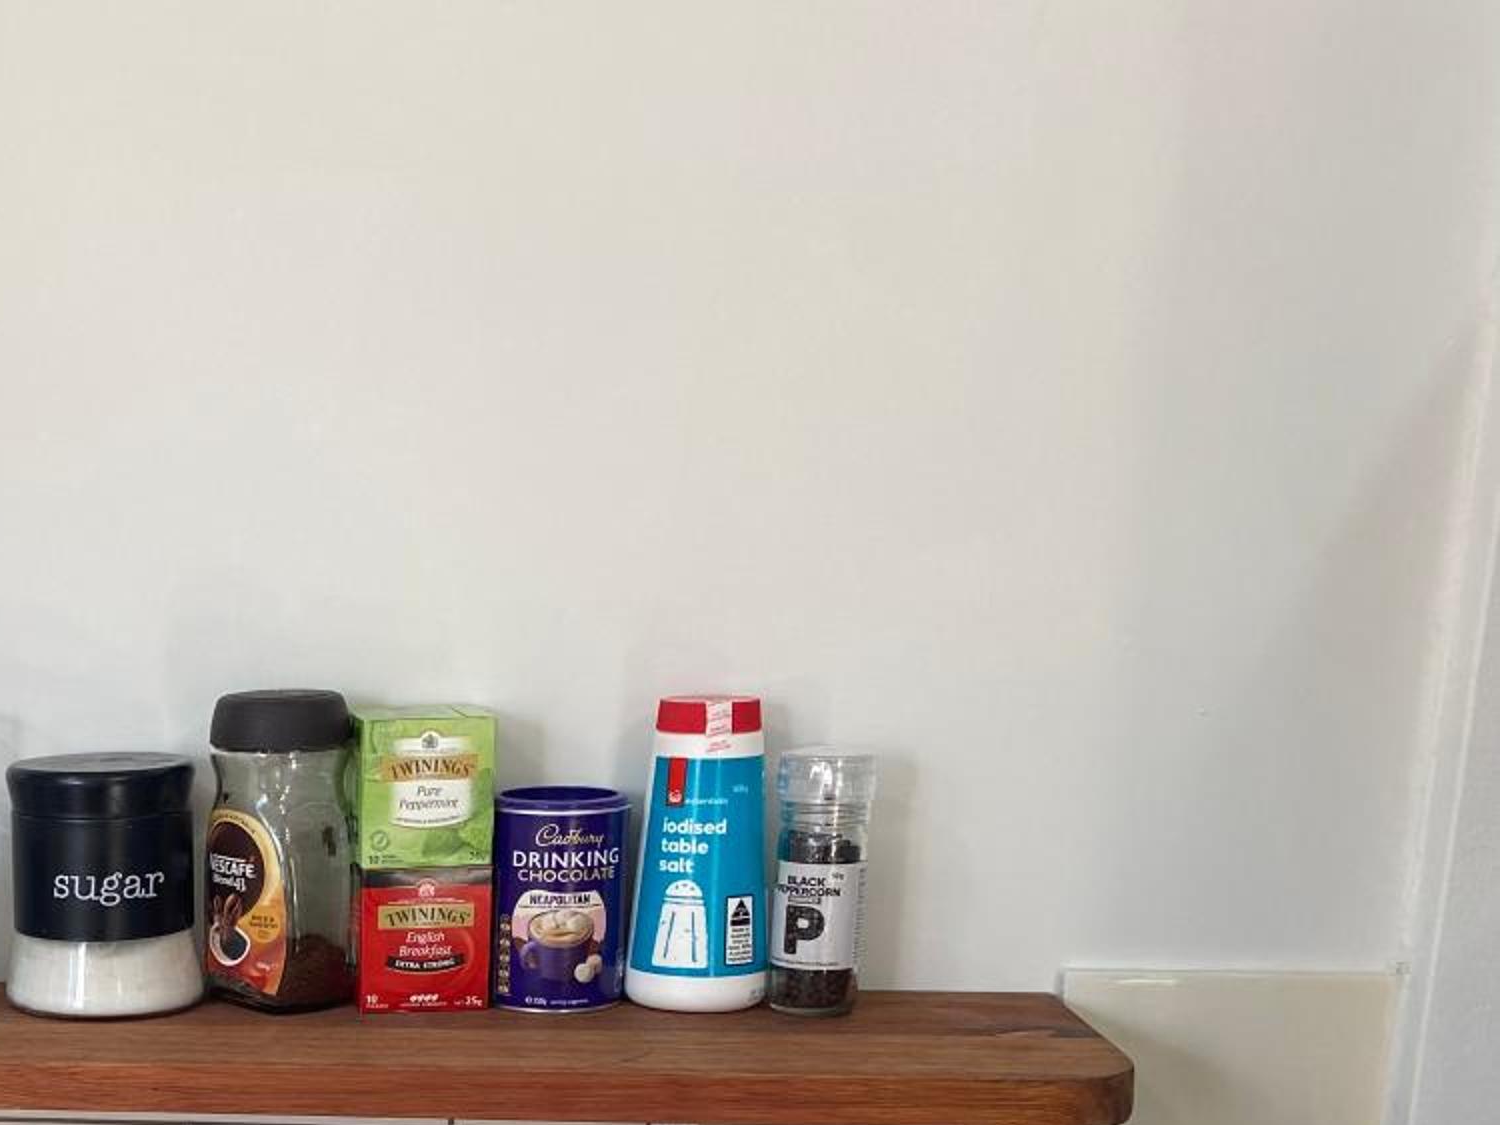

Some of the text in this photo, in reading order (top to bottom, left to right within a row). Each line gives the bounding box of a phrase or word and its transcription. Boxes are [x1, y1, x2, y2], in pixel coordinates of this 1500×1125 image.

[387, 757, 474, 780] TWININGS
[417, 785, 443, 797] Pure
[662, 816, 728, 835] iodised
[535, 823, 605, 848] Cadbury
[661, 838, 709, 855] table
[513, 847, 620, 868] DRINKING
[659, 857, 694, 874] salt
[517, 866, 615, 883] CHOCOLATE
[787, 875, 826, 887] BLACK
[53, 871, 165, 906] sugar
[529, 893, 591, 905] NEAPOLITAN
[385, 905, 469, 927] TWININGS
[405, 931, 446, 944] English
[784, 904, 825, 955] P
[399, 945, 453, 958] Breakfast
[395, 959, 421, 969] EXTRA
